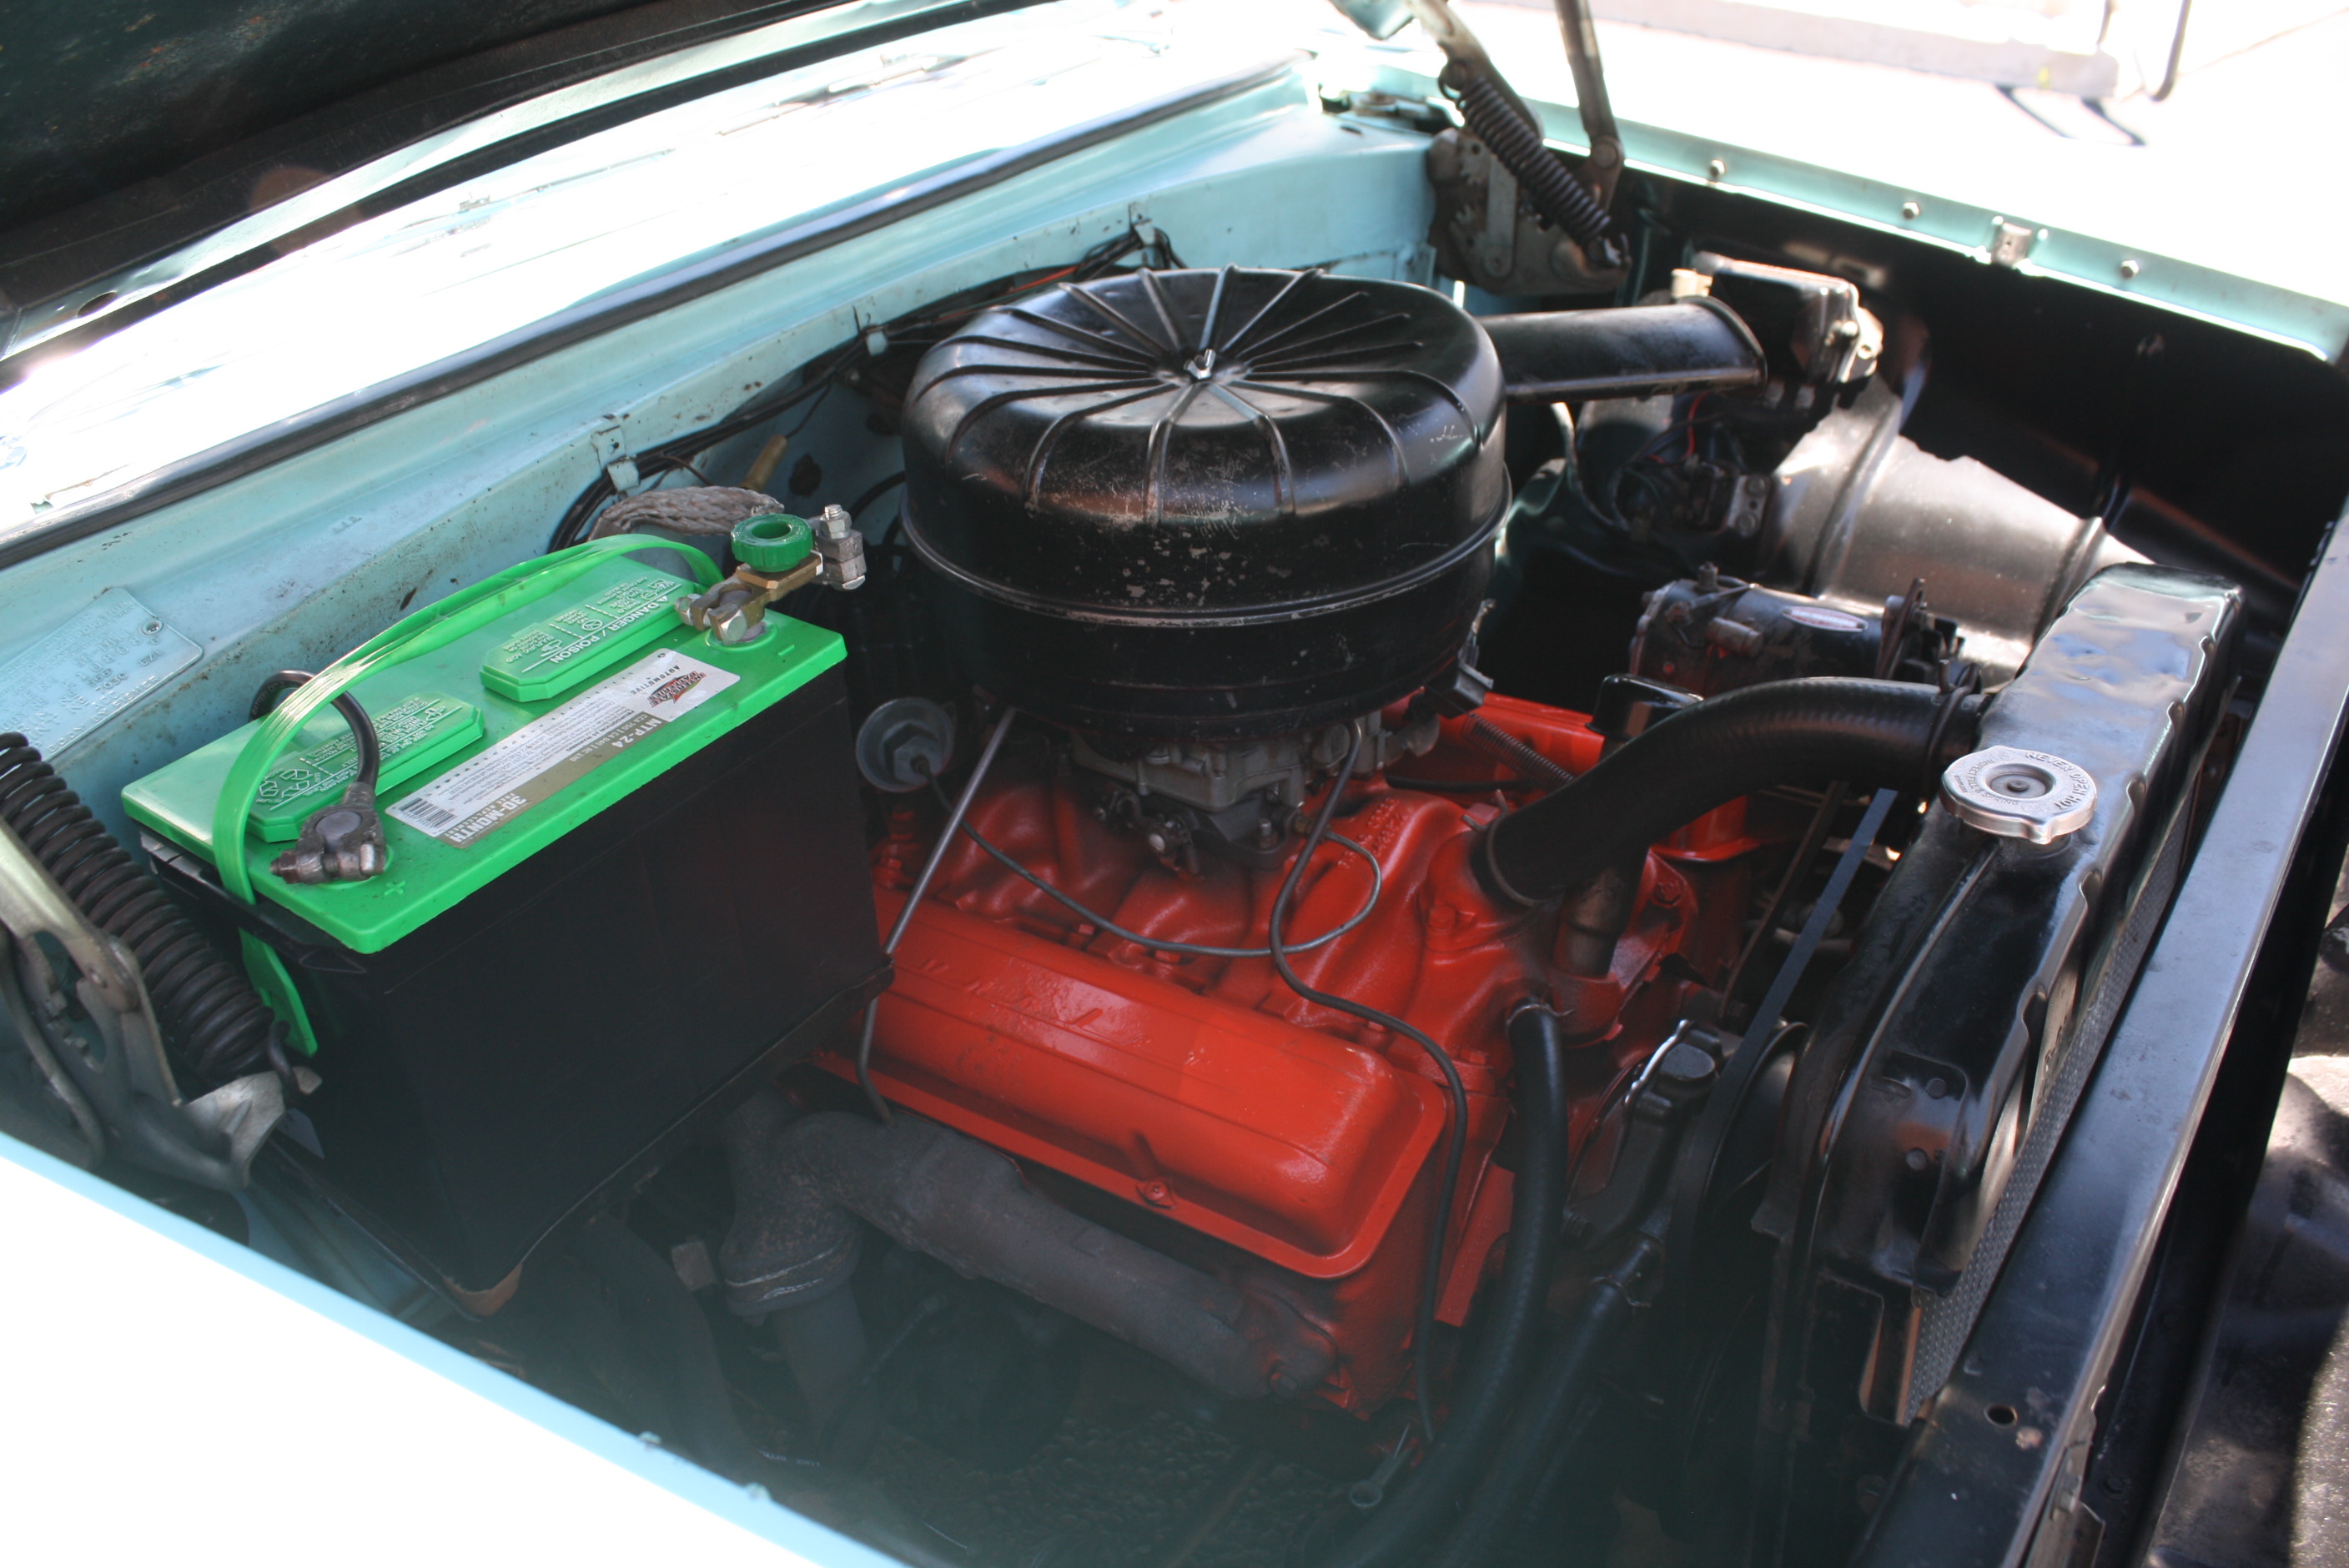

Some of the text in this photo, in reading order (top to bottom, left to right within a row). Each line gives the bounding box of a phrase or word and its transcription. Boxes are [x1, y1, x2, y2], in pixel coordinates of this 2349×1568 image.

[51, 598, 129, 654] CORPORATION
[606, 601, 661, 631] DANGER
[548, 634, 601, 663] POISON
[628, 664, 682, 695] AUTOMOTIVE
[44, 675, 158, 752] BODY BY FISHER
[598, 710, 636, 731] PROPOSITION
[631, 713, 649, 722] CCA
[565, 735, 593, 751] WARNING
[609, 717, 663, 748] MTP-24
[2025, 751, 2089, 810] NEVER OPEN HOT
[495, 792, 516, 804] FREE
[1982, 793, 2020, 806] SPRING
[442, 804, 496, 837] REPLACEMENT
[447, 795, 528, 842] 30-MONTH
